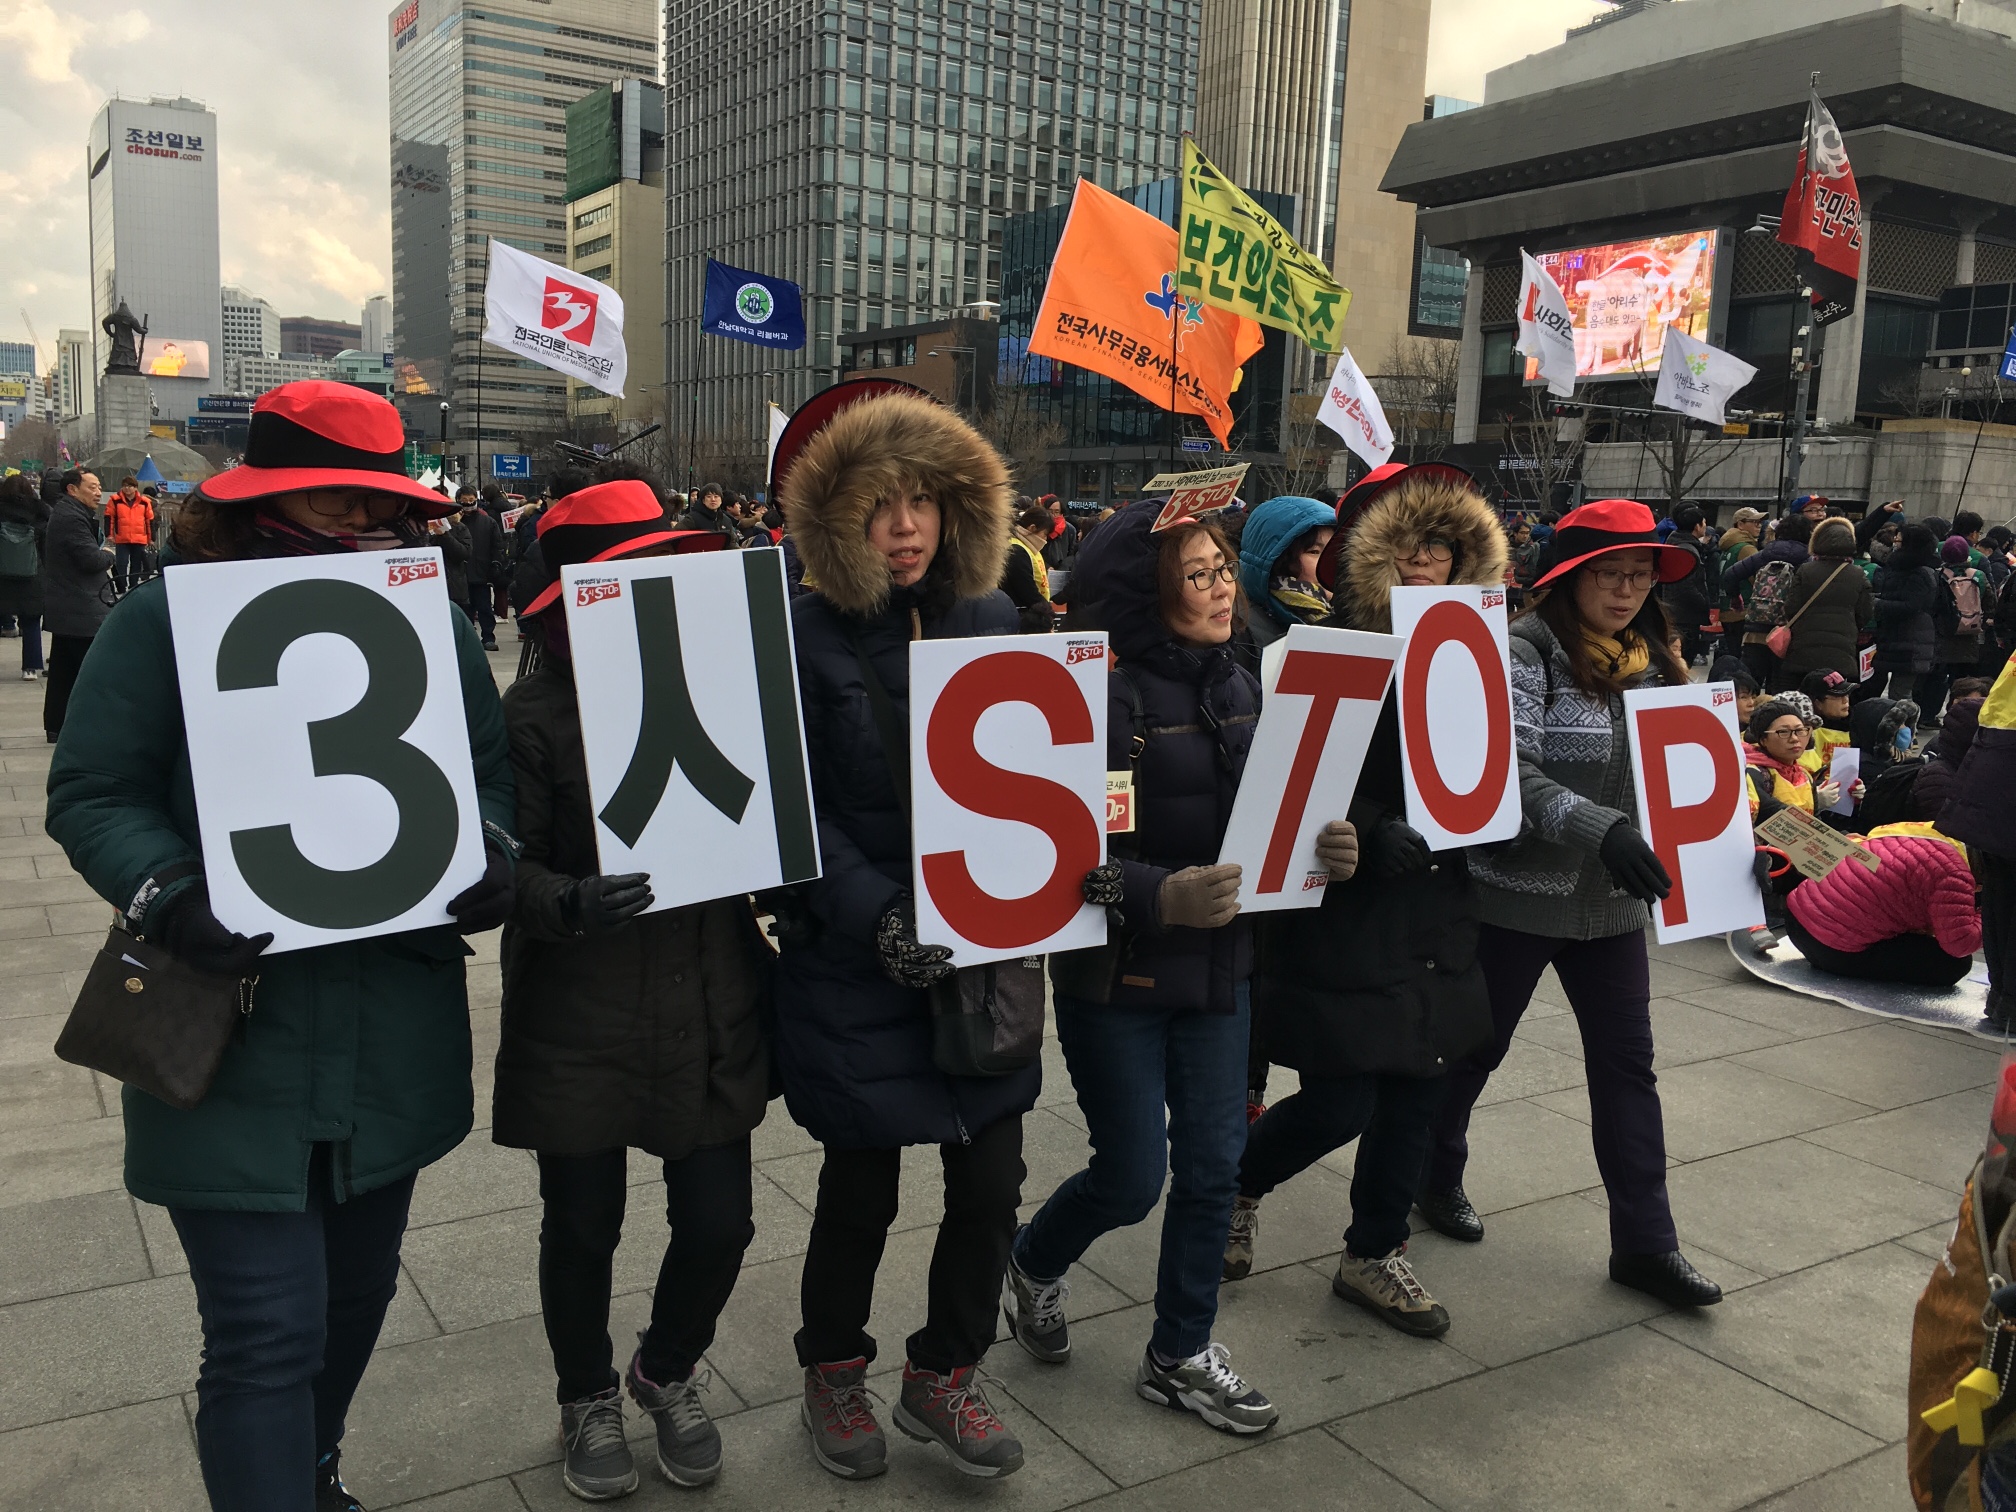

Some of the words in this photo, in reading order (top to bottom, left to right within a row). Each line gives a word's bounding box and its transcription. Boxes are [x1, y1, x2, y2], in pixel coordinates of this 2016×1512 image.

[125, 127, 204, 151] 조선일보
[127, 144, 202, 161] chosun.com
[512, 339, 541, 353] NATIONAL
[541, 348, 561, 360] UNION
[514, 325, 614, 374] 전국언론노동조합
[1053, 335, 1088, 349] KOREAN
[1092, 346, 1127, 367] FINANCE
[1137, 370, 1173, 392] SERVICE
[409, 564, 436, 579] STOP
[594, 585, 619, 599] STOP
[1082, 646, 1103, 659] STOP
[598, 550, 818, 884] 시
[1402, 600, 1512, 835] O
[216, 578, 459, 929] 3
[1255, 649, 1395, 894] T
[1114, 780, 1128, 790] 시위
[921, 650, 1101, 949] S
[1106, 798, 1126, 821] OP
[1636, 704, 1741, 928] P
[1023, 960, 1040, 968] adidas
